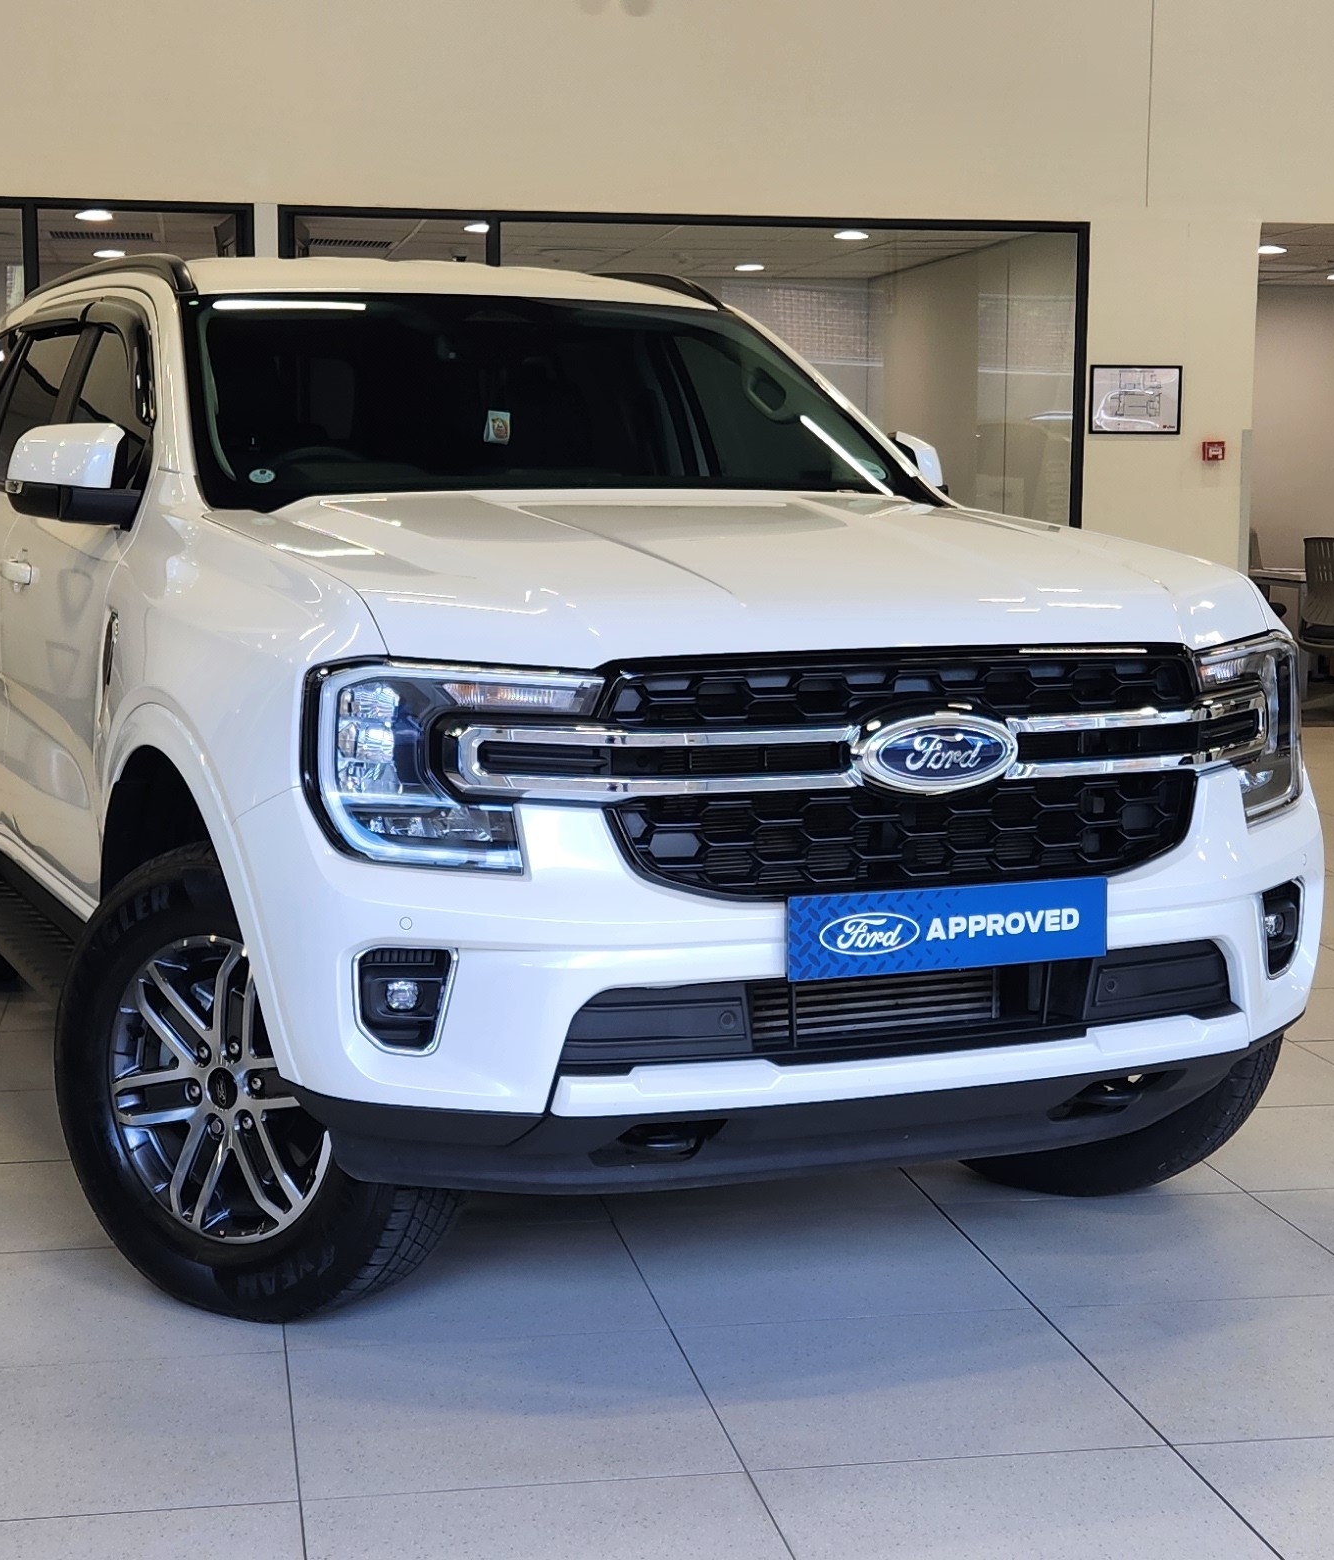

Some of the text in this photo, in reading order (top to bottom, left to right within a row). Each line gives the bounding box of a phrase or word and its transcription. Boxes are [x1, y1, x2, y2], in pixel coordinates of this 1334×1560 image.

[905, 734, 982, 771] Ford
[836, 908, 1080, 949] Ford APPROVED
